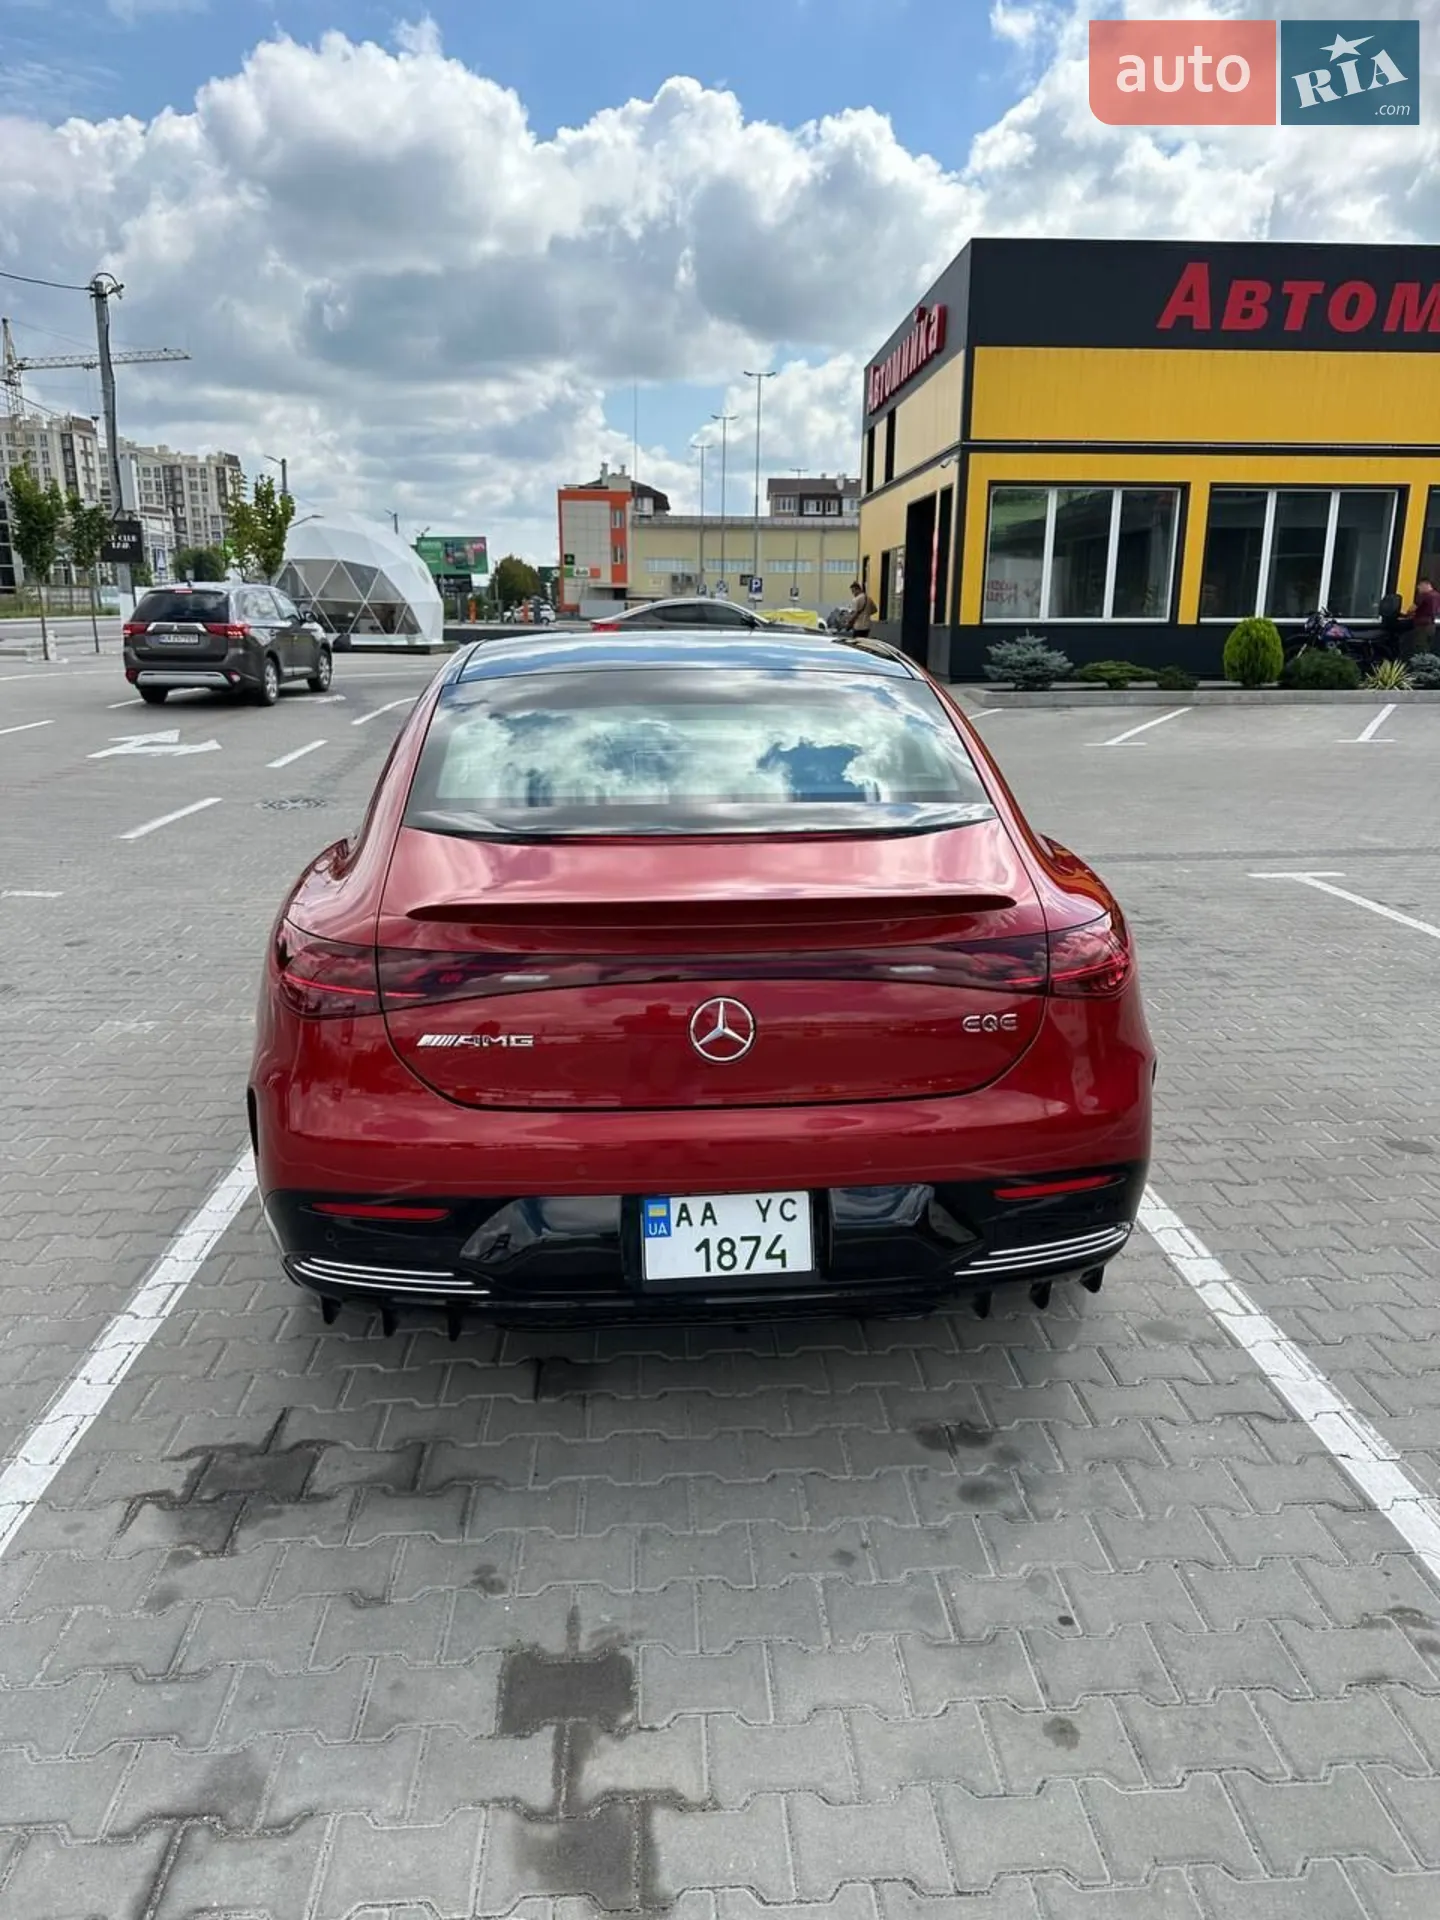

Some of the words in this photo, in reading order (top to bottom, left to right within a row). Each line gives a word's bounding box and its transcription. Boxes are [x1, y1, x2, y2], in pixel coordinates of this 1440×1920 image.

[962, 1013, 1018, 1033] EQE
[453, 1034, 535, 1048] AMG
[648, 1222, 669, 1236] UA
[694, 1233, 788, 1273] 1874
